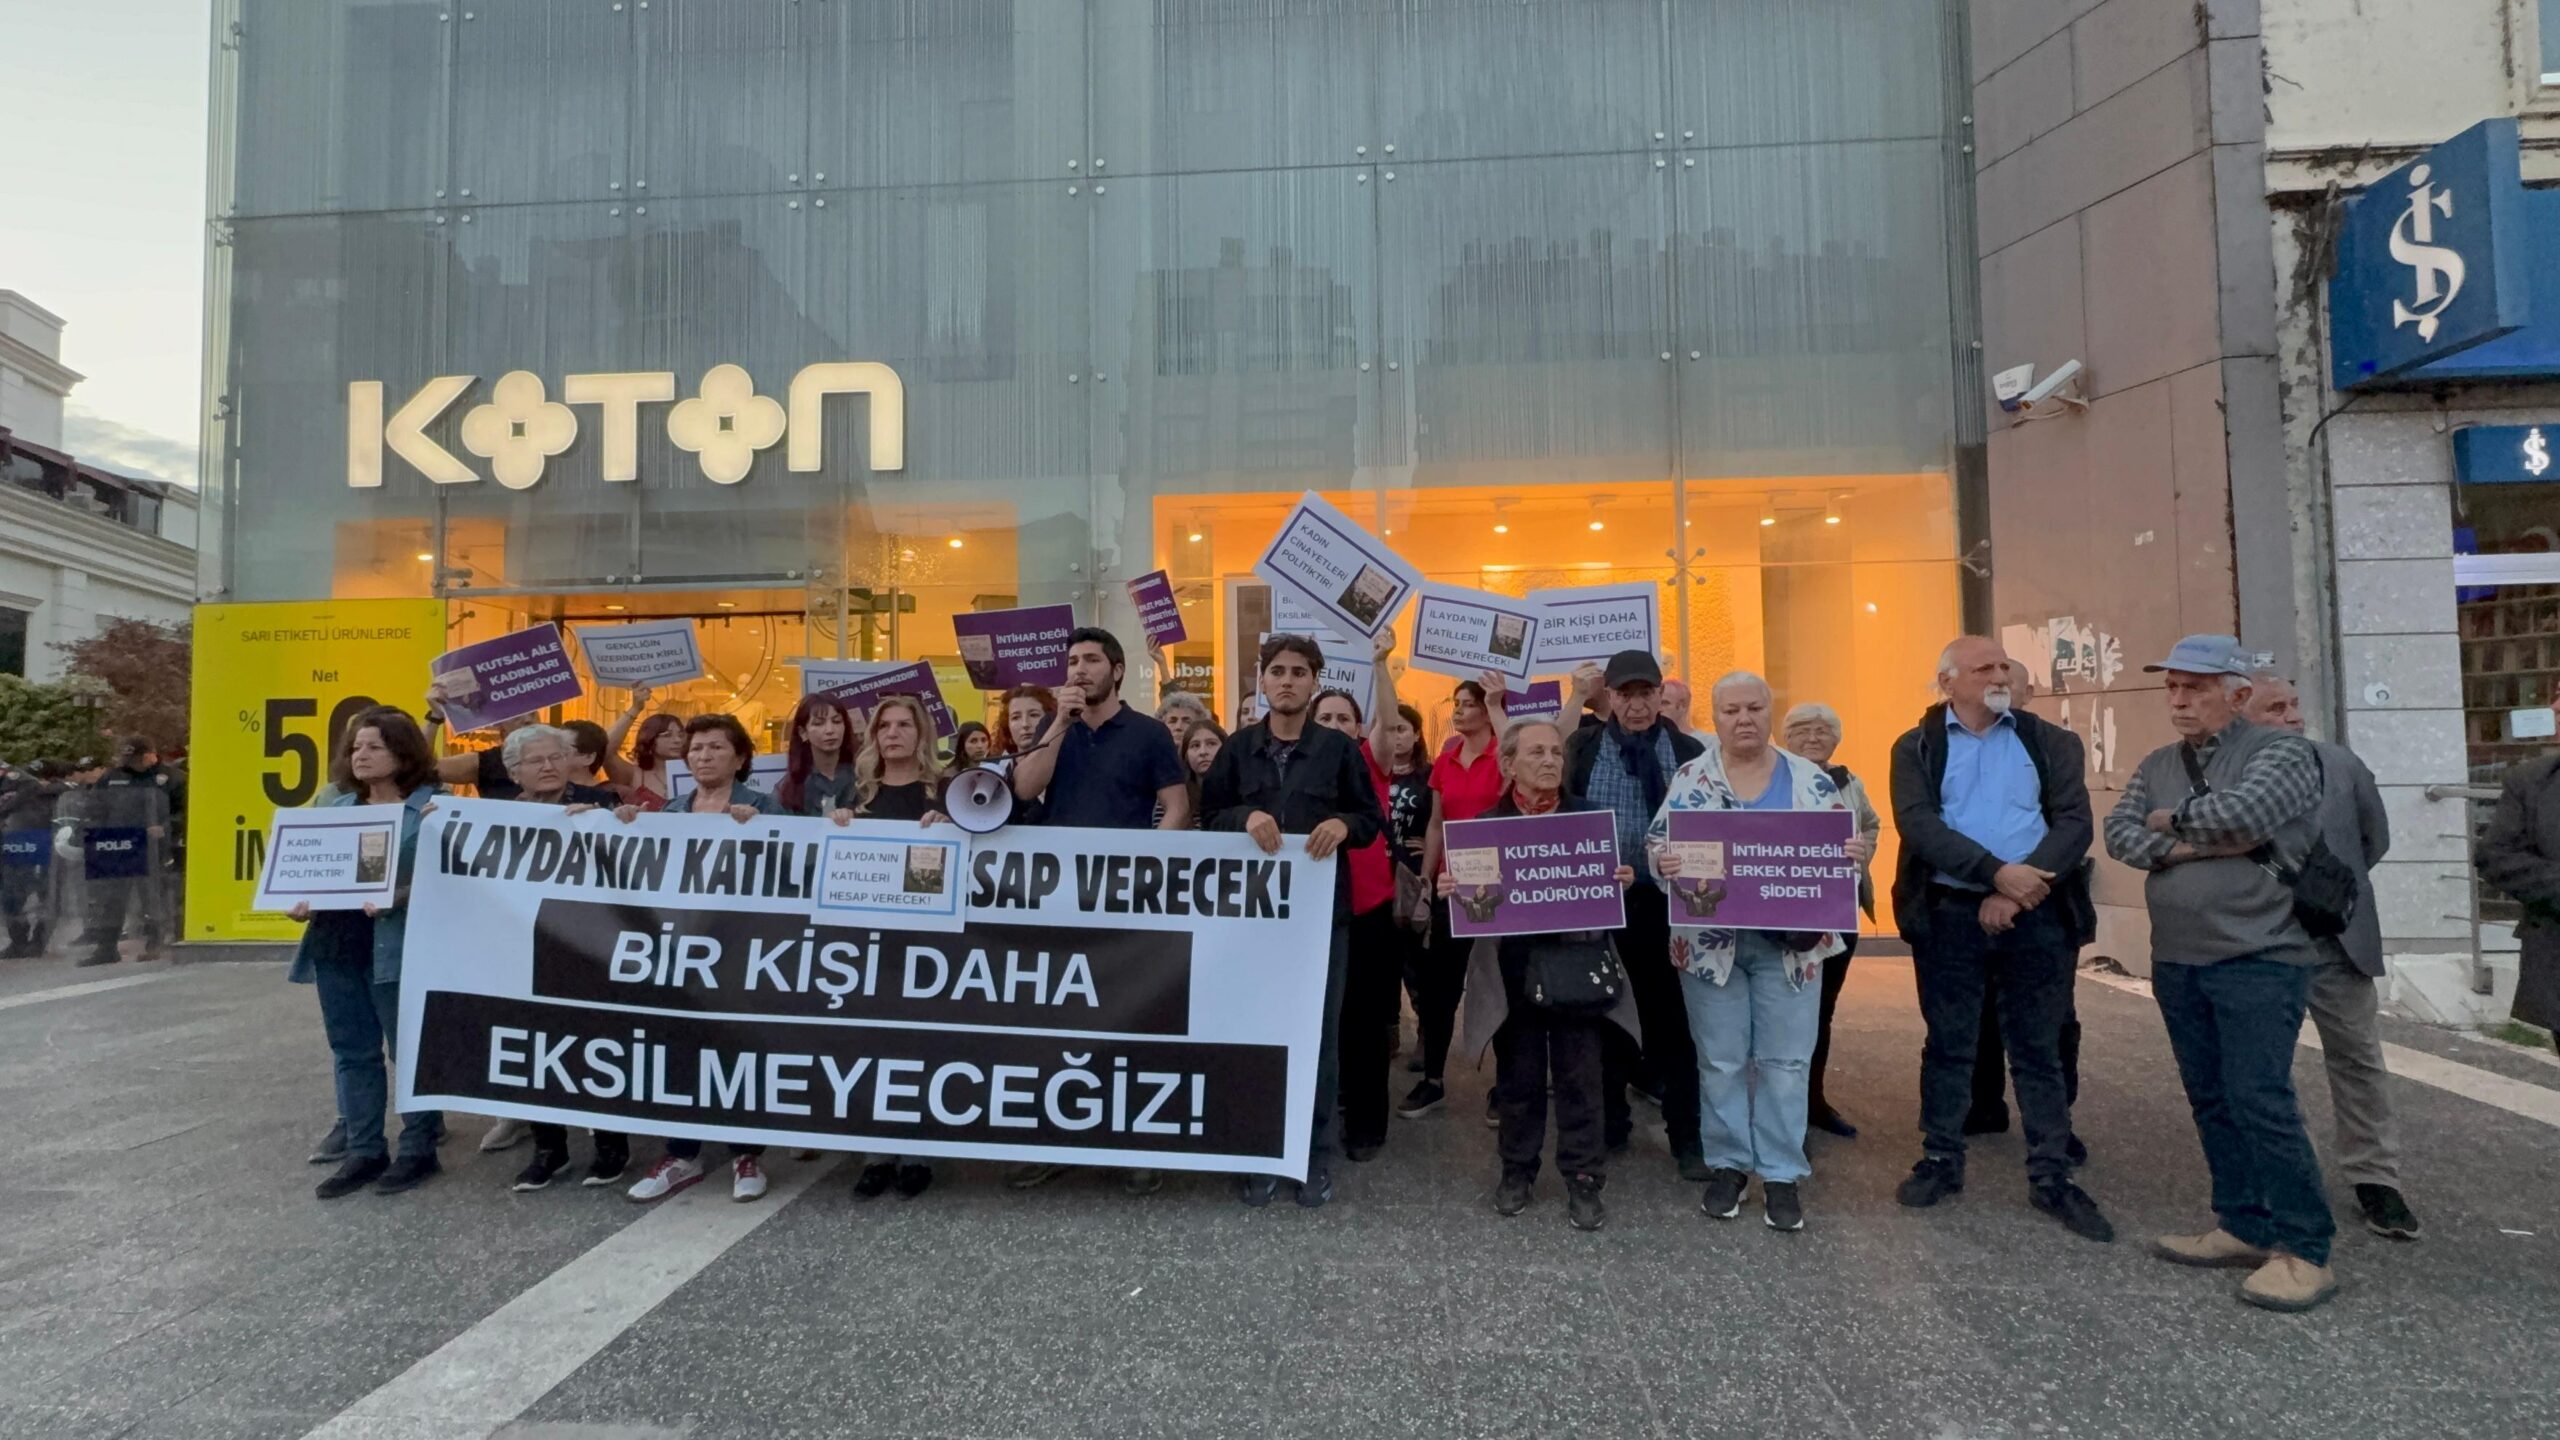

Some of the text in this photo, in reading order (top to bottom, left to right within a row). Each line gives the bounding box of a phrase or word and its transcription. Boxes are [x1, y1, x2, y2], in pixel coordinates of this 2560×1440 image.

[348, 362, 903, 489] KOTON
[1429, 610, 1488, 627] İLAYDA'NIN
[1569, 613, 1595, 627] KİŞİ
[1600, 612, 1637, 624] DAHA
[241, 626, 412, 642] SARI ETİKETLİ ÜRÜNLERDE
[996, 632, 1037, 644] İNTİHAR
[475, 641, 561, 674] KUTSAL AİLE
[998, 643, 1068, 658] ERKEK DEVLE
[1424, 643, 1510, 667] HESAP VERECEK!
[489, 658, 560, 687] KADINLARI
[1017, 657, 1057, 672] ŞİDDETİ
[312, 669, 339, 682] Net
[490, 671, 571, 702] ÖLDÜRÜYOR
[287, 838, 322, 848] KADIN
[1504, 838, 1612, 860] KUTSAL AİLE
[1732, 843, 1847, 858] İNTİHAR DEĞİL
[440, 810, 671, 891] İLAYDA'NIN
[1076, 854, 1292, 920] VERECEK!
[834, 850, 899, 864] İLAYDA'NIN
[831, 871, 891, 883] KATİLLERİ
[1515, 863, 1605, 881] KADINLARI
[1732, 865, 1854, 879] ERKEK DEVLET
[829, 891, 931, 906] HESAP VERECEK!
[1509, 885, 1615, 905] ÖLDÜRÜYOR
[1759, 883, 1822, 900] ŞİDDETİ
[609, 922, 1099, 1009] BİR KİŞİ DAHA
[488, 1026, 1205, 1136] EKSİLMEYECEĞİZ!
